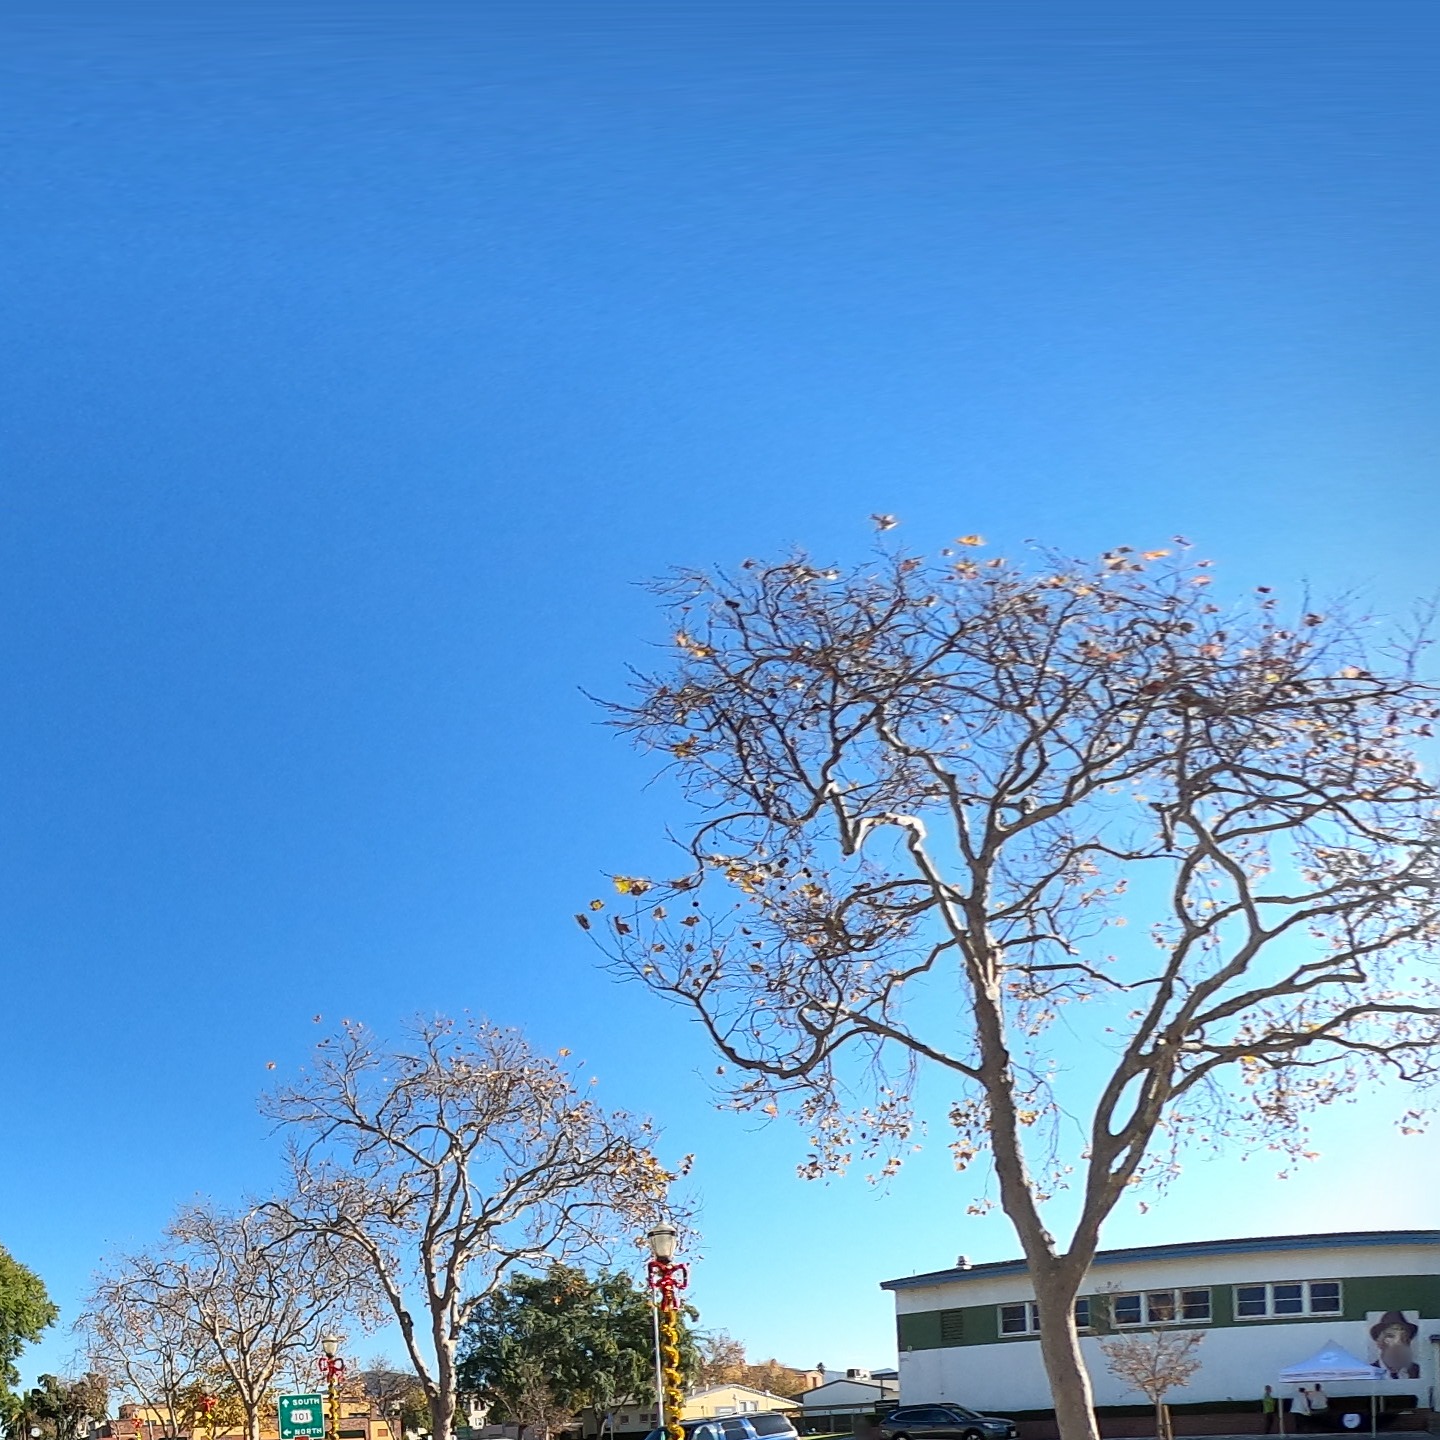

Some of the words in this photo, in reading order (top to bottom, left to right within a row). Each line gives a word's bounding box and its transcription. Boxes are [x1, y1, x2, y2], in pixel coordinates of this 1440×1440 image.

[292, 1398, 320, 1406] SOUTH
[294, 1412, 309, 1421] 101
[294, 1428, 322, 1436] NORTH
